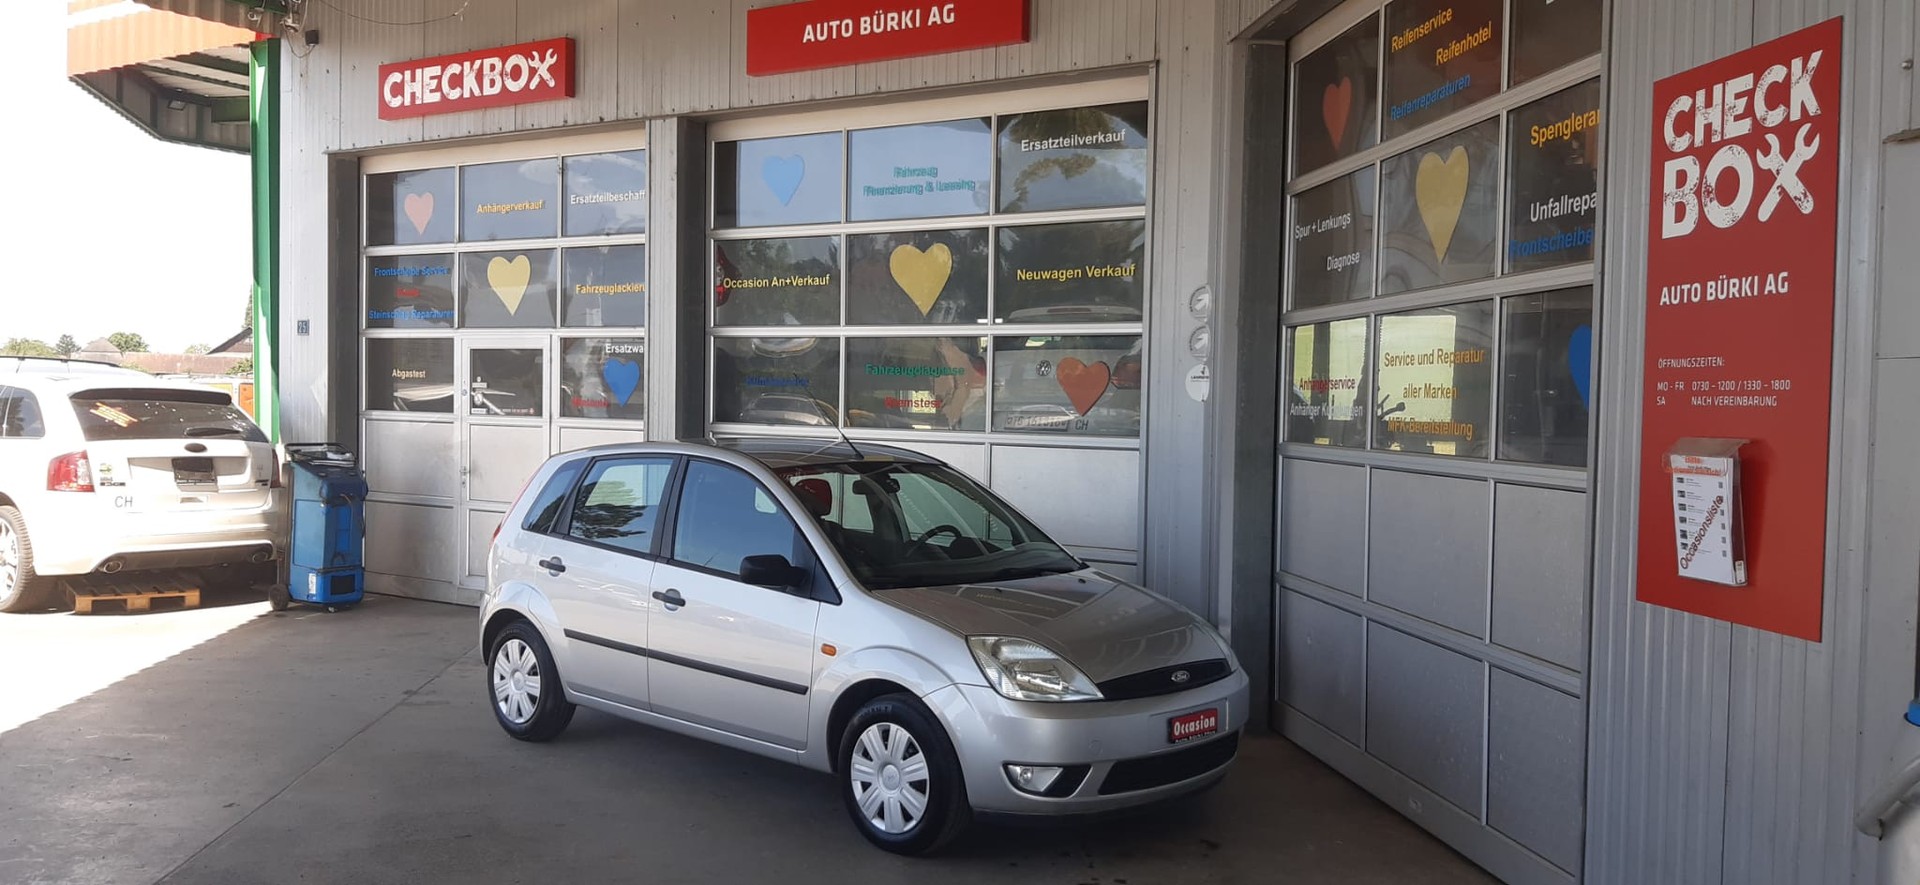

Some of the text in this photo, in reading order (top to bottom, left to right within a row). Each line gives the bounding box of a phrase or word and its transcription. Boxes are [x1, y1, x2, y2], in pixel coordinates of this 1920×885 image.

[802, 3, 956, 43] AUTO BÜRKI AG
[1391, 8, 1453, 52] Reifenservice
[1436, 22, 1492, 66] Reifenhotel
[383, 48, 558, 107] CHECKBOX
[1391, 74, 1472, 121] Reifenreparaturen
[1663, 50, 1823, 153] CHECK
[1020, 129, 1127, 153] Ersatzteilverkauf
[1661, 123, 1820, 240] BOX
[476, 200, 543, 214] Anhängerverkauf
[1294, 222, 1311, 239] Spur
[1317, 212, 1352, 232] Lenkungs
[1326, 250, 1361, 272] Diagnose
[723, 274, 831, 288] Occasion An+Verkauf
[1016, 262, 1136, 282] Neuwagen Verkauf
[1660, 272, 1789, 305] AUTO BÜRKI AG
[605, 344, 644, 354] Ersatzwa
[1384, 347, 1484, 367] Service und Reparatur
[1658, 356, 1725, 369] ÖFFNUNGSZEITEN:
[392, 368, 426, 379] Abgastest
[1403, 383, 1458, 400] aller Marken
[1657, 382, 1668, 391] MO
[1675, 382, 1684, 391] FR
[1691, 381, 1710, 391] 0730
[1718, 381, 1735, 391] 1200
[1743, 380, 1761, 391] 1330
[1771, 380, 1790, 390] 1800
[1656, 396, 1778, 406] SA NACH VEREINBARUNG
[1290, 403, 1320, 422] Anhänger
[1075, 419, 1089, 431] CH
[1387, 416, 1473, 440] MFK-Bereitstellung
[114, 496, 134, 508] CH
[1680, 495, 1724, 570] Occasionsliste
[1174, 715, 1216, 736] Occasion
